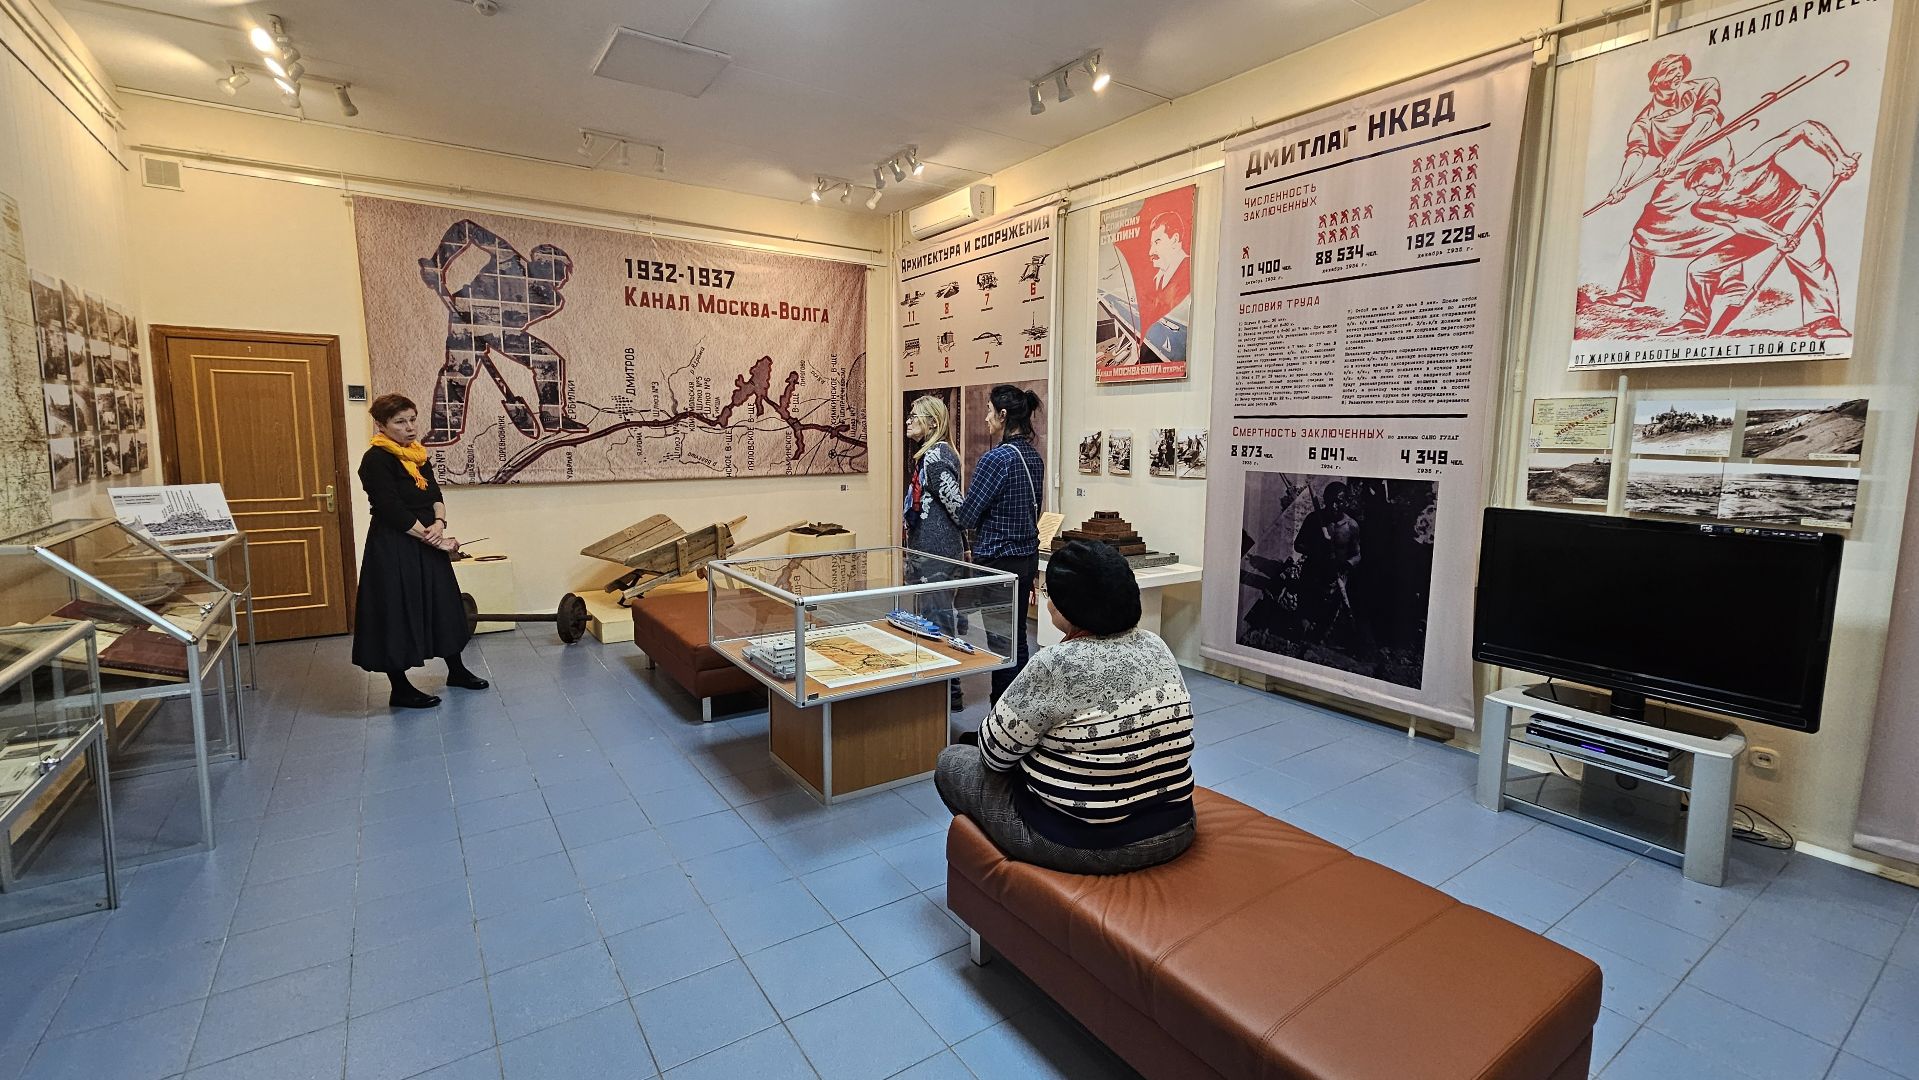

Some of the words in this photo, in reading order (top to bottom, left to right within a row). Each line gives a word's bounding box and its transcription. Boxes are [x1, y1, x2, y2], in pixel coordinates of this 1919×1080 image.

[1708, 0, 1877, 46] КАНАЛОАРМЕ
[1367, 90, 1456, 142] НКВД
[1243, 183, 1317, 208] ЧИСЛЕННОСТЬ
[1243, 196, 1317, 222] ЗАКЛЮЧЕННЫХ
[901, 243, 961, 273] АРХИТЕКТУРА
[964, 240, 971, 254] И
[974, 214, 1050, 251] СООРУЖЕНИЯ
[1406, 231, 1436, 250] 192
[1441, 224, 1475, 244] 229
[1315, 250, 1333, 266] 88
[1337, 244, 1364, 262] 534
[625, 258, 735, 289] 1932-1937
[1241, 264, 1254, 278] 10
[1258, 259, 1281, 275] 400
[1030, 282, 1036, 295] 6
[985, 293, 990, 305] 7
[1239, 300, 1283, 315] УСЛОВИЯ
[1287, 295, 1320, 308] ТРУДА
[944, 302, 949, 314] 8
[985, 351, 990, 363] 7
[1024, 343, 1042, 359] 240
[1588, 352, 1631, 365] ЖАРКОЙ
[1635, 348, 1680, 361] РАБОТЫ
[1685, 344, 1740, 359] РАСТАЕТ
[1749, 342, 1783, 355] ТВОЙ
[1790, 340, 1826, 353] СРОК
[909, 362, 914, 372] 5
[944, 357, 949, 368] 8
[1112, 364, 1162, 377] МОСКВА-ВОЛГА
[624, 347, 636, 396] ДМИТРОВ
[1232, 426, 1297, 438] СМЕРТНОСТЬ
[1301, 428, 1384, 439] ЗАКЛЮЧЕННЫХ
[1231, 445, 1238, 457] 8
[1241, 445, 1262, 458] 873
[1308, 447, 1317, 460] 6
[1321, 447, 1345, 461] 041
[1400, 449, 1410, 464] 4
[1416, 450, 1448, 465] 349
